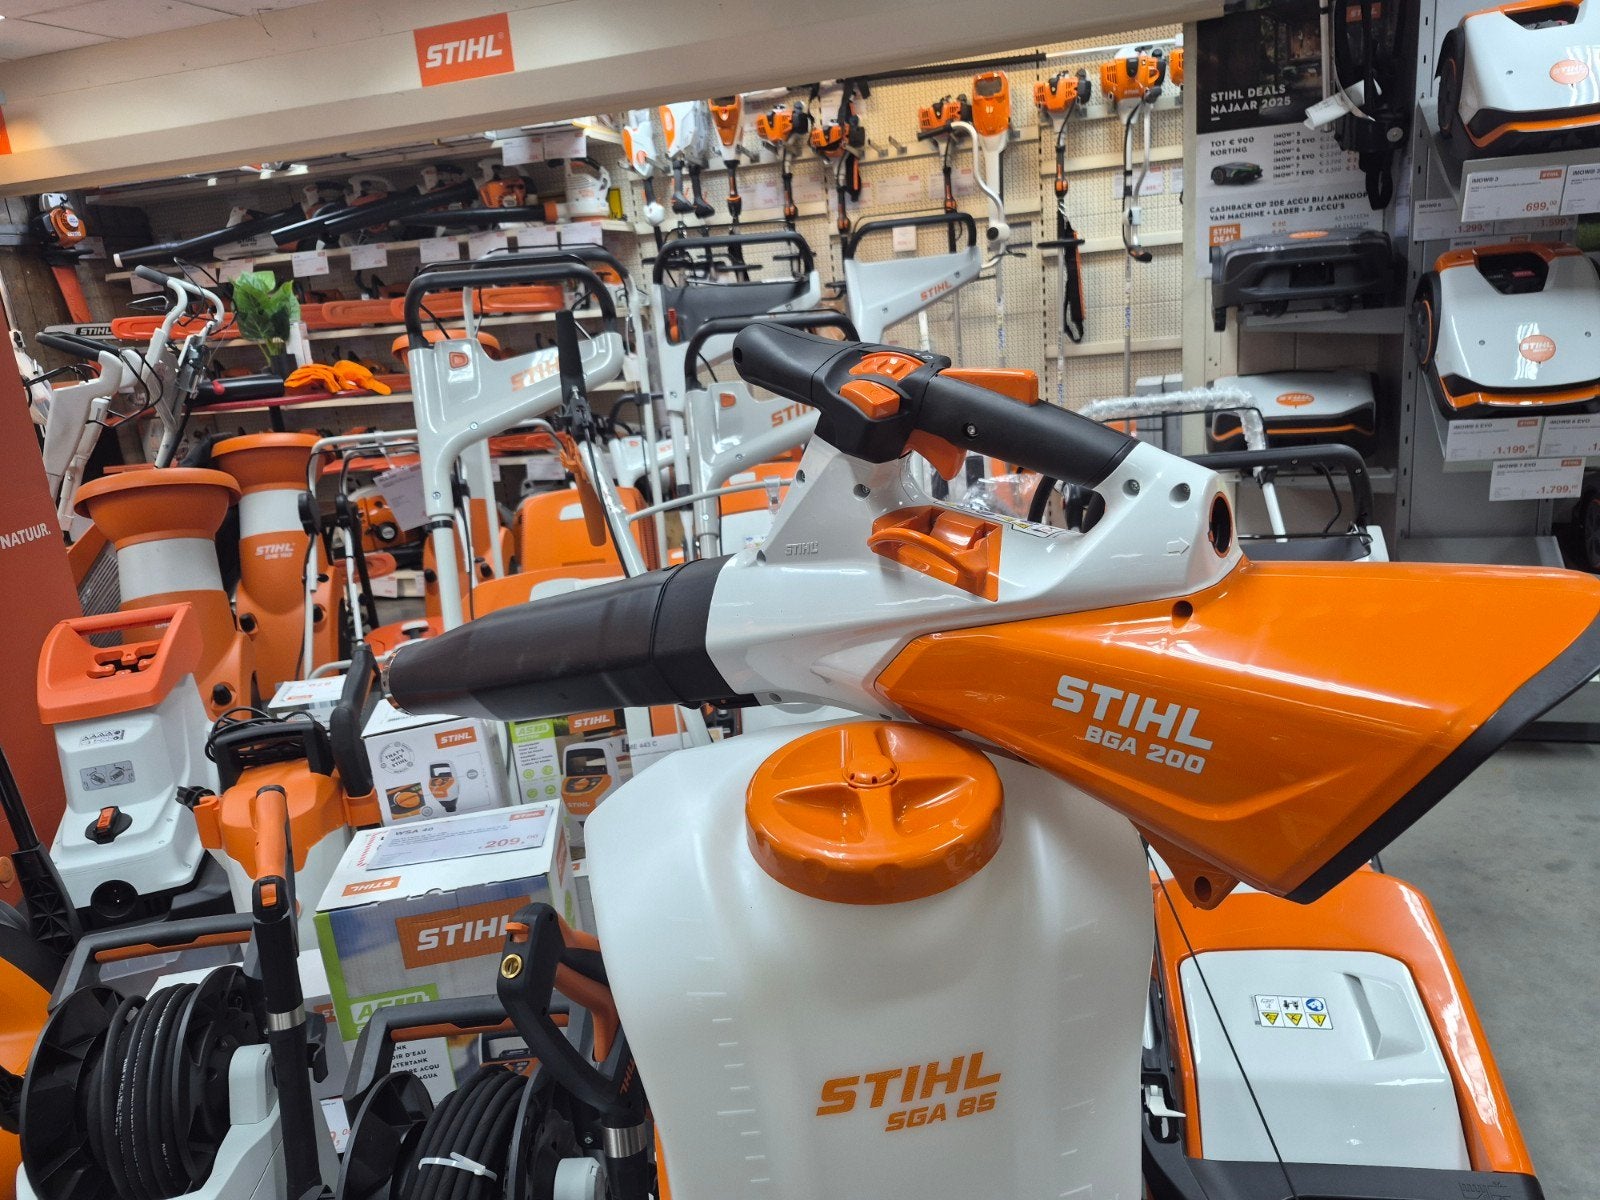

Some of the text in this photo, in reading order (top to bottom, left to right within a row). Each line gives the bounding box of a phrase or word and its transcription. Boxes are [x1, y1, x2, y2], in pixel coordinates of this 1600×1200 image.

[425, 34, 503, 69] STIHL
[1210, 84, 1286, 103] STIHL DEALS
[1210, 96, 1292, 115] NAJAAR 2025
[1210, 146, 1248, 157] KORTING
[1211, 136, 1255, 148] TOT € 900
[1209, 204, 1253, 214] CASHBACK
[1255, 201, 1267, 209] OP
[1287, 197, 1310, 206] ACCU
[1311, 195, 1324, 203] BIJ
[1327, 192, 1369, 202] AANKOOP
[1210, 213, 1225, 222] VAN
[1228, 210, 1264, 220] MACHINE
[1273, 207, 1300, 216] LADER
[1315, 203, 1345, 212] ACCU'S
[1212, 226, 1238, 236] STIHL
[920, 280, 952, 302] STIHL
[79, 327, 113, 336] STIHL
[510, 356, 561, 393] STIH
[0, 523, 51, 549] NATUUR.
[255, 543, 294, 557] STIHL
[784, 541, 819, 556] STIHL
[573, 714, 611, 729] STIHL
[1051, 674, 1214, 751] STIHL
[440, 732, 473, 744] STIHL
[385, 748, 405, 760] THAT'S
[1085, 725, 1206, 774] BGA 200
[391, 759, 408, 768] STIHL
[350, 880, 395, 892] STIHL
[417, 914, 510, 951] STIHL
[392, 1057, 429, 1069] ATERTANK
[816, 1051, 1002, 1116] STIHL
[885, 1091, 997, 1132] SGA 85
